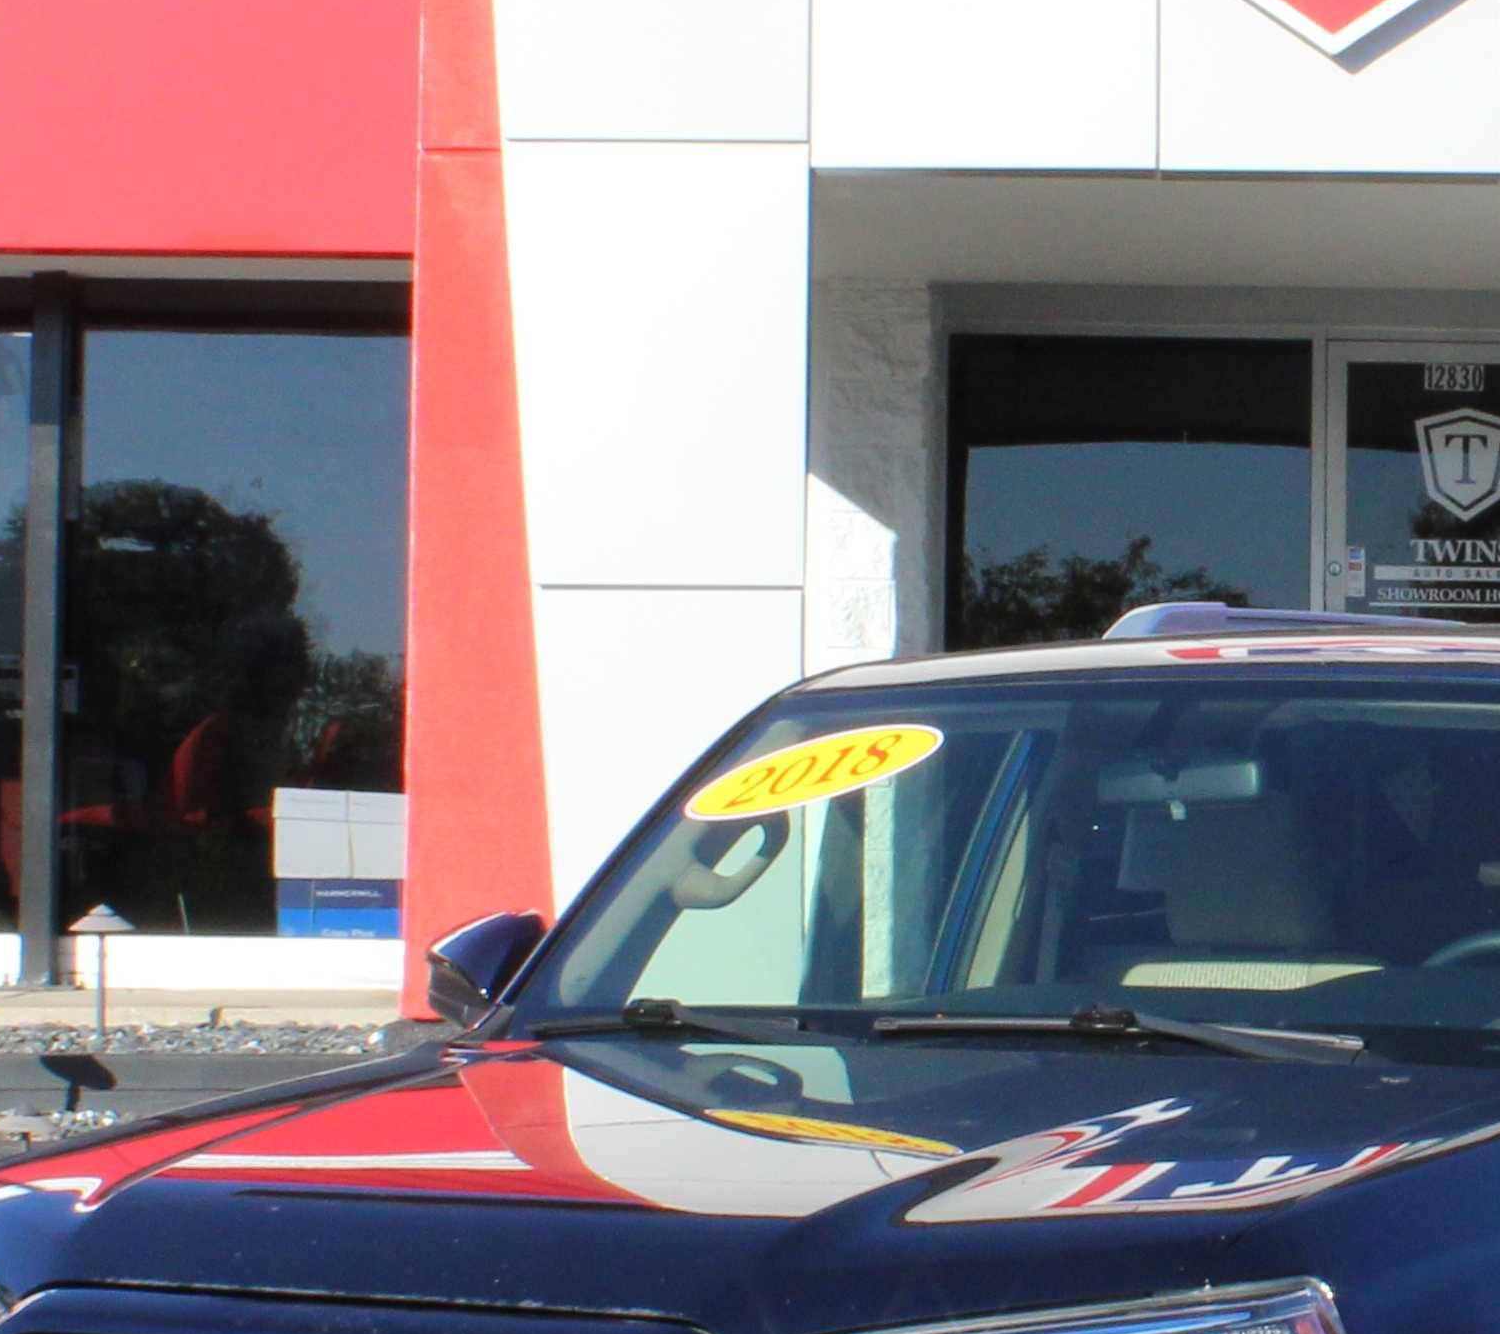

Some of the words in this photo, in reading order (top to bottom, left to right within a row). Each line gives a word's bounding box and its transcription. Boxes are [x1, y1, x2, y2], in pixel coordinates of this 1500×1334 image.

[1424, 365, 1484, 390] 12830
[1444, 434, 1488, 485] T
[1377, 586, 1481, 602] SHOWROOM
[723, 733, 902, 810] 2018
